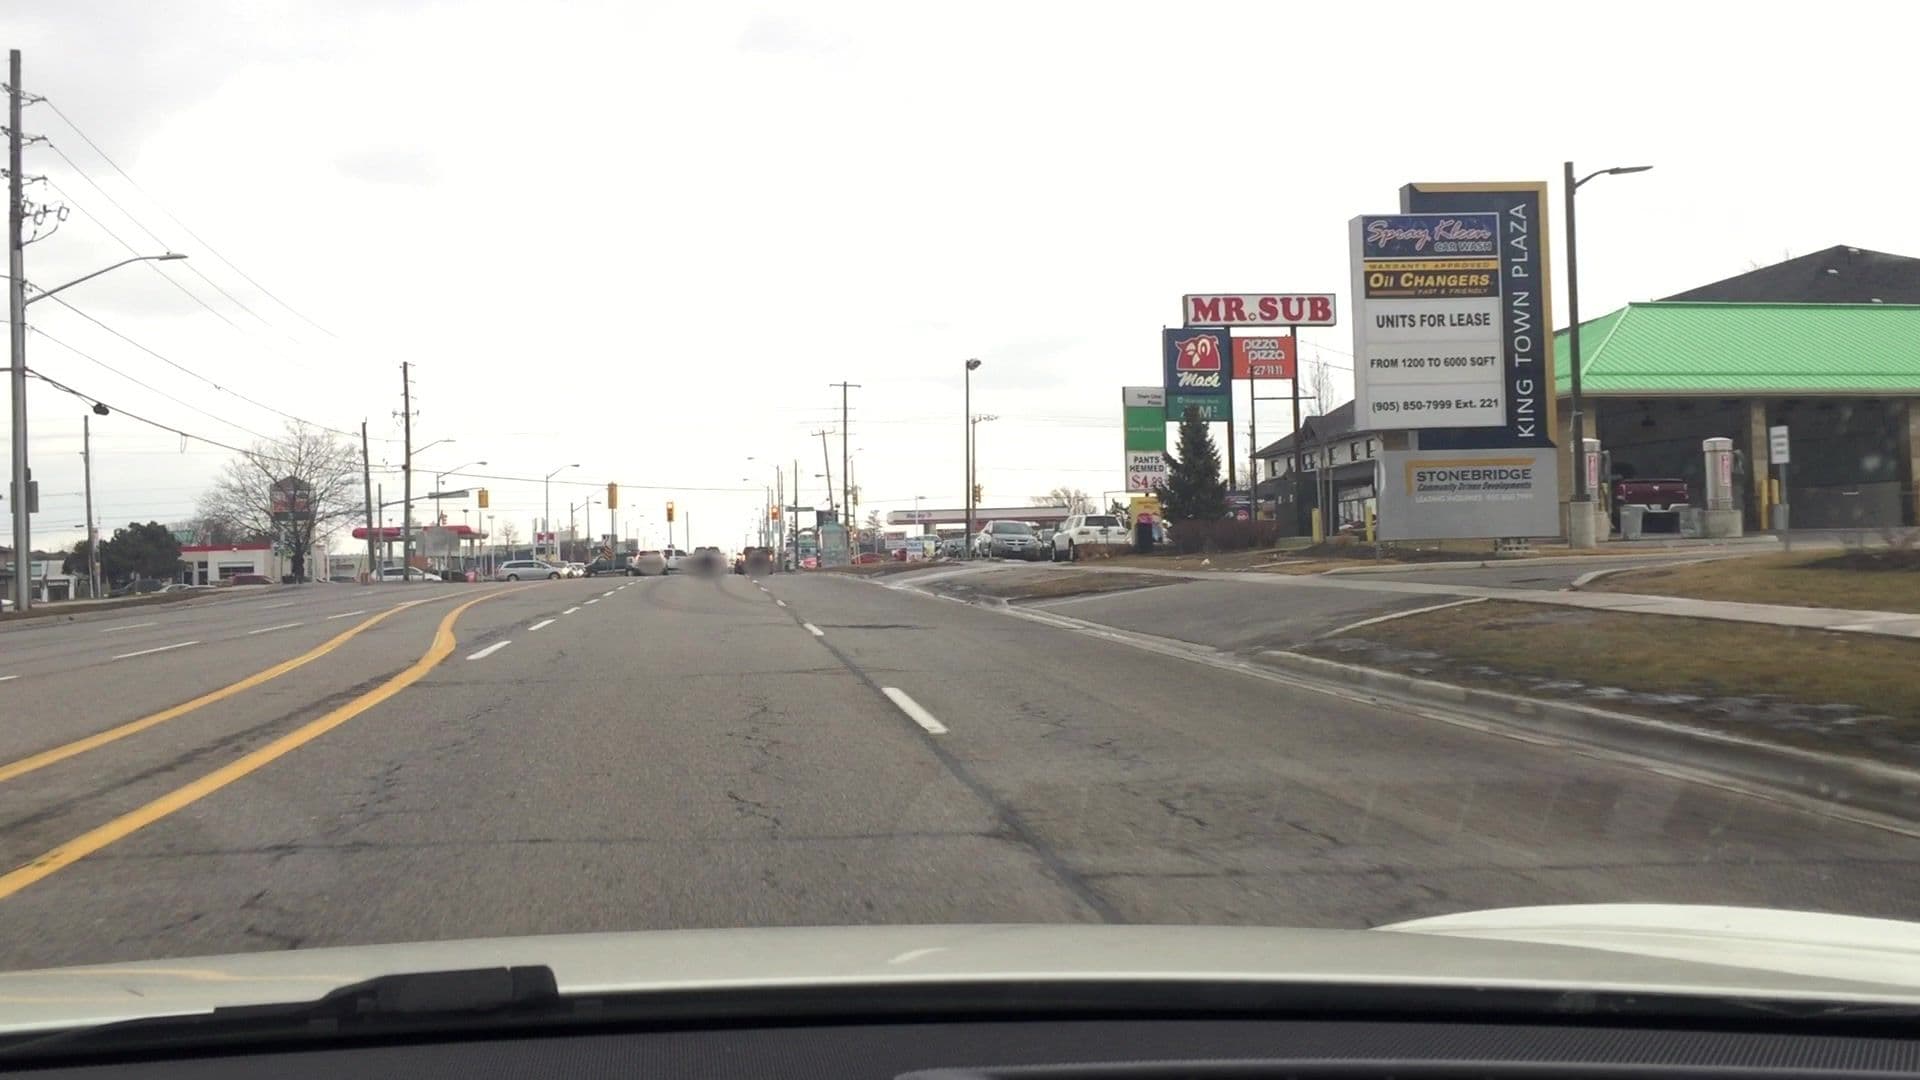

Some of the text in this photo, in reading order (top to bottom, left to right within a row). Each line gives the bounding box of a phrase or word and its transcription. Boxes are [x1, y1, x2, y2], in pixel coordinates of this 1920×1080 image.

[1367, 219, 1491, 251] Spray Kleen
[1434, 241, 1492, 252] CAR WASH
[1400, 272, 1490, 287] CHANGERS
[1376, 312, 1491, 328] UNITS FOR LEASE
[1509, 203, 1535, 438] KING TOWN PLAZA
[1242, 339, 1279, 353] pizza
[1248, 350, 1285, 364] pizza
[1370, 356, 1496, 368] FROM 1200 TO 6000 SQFT
[1372, 398, 1499, 413] (905) 850-7999 Ext. 221
[1133, 456, 1160, 464] PANTS
[1129, 464, 1165, 473] HEMMED
[1416, 468, 1532, 483] STONEBRIDGE
[1417, 480, 1532, 493] Community Driven Developments
